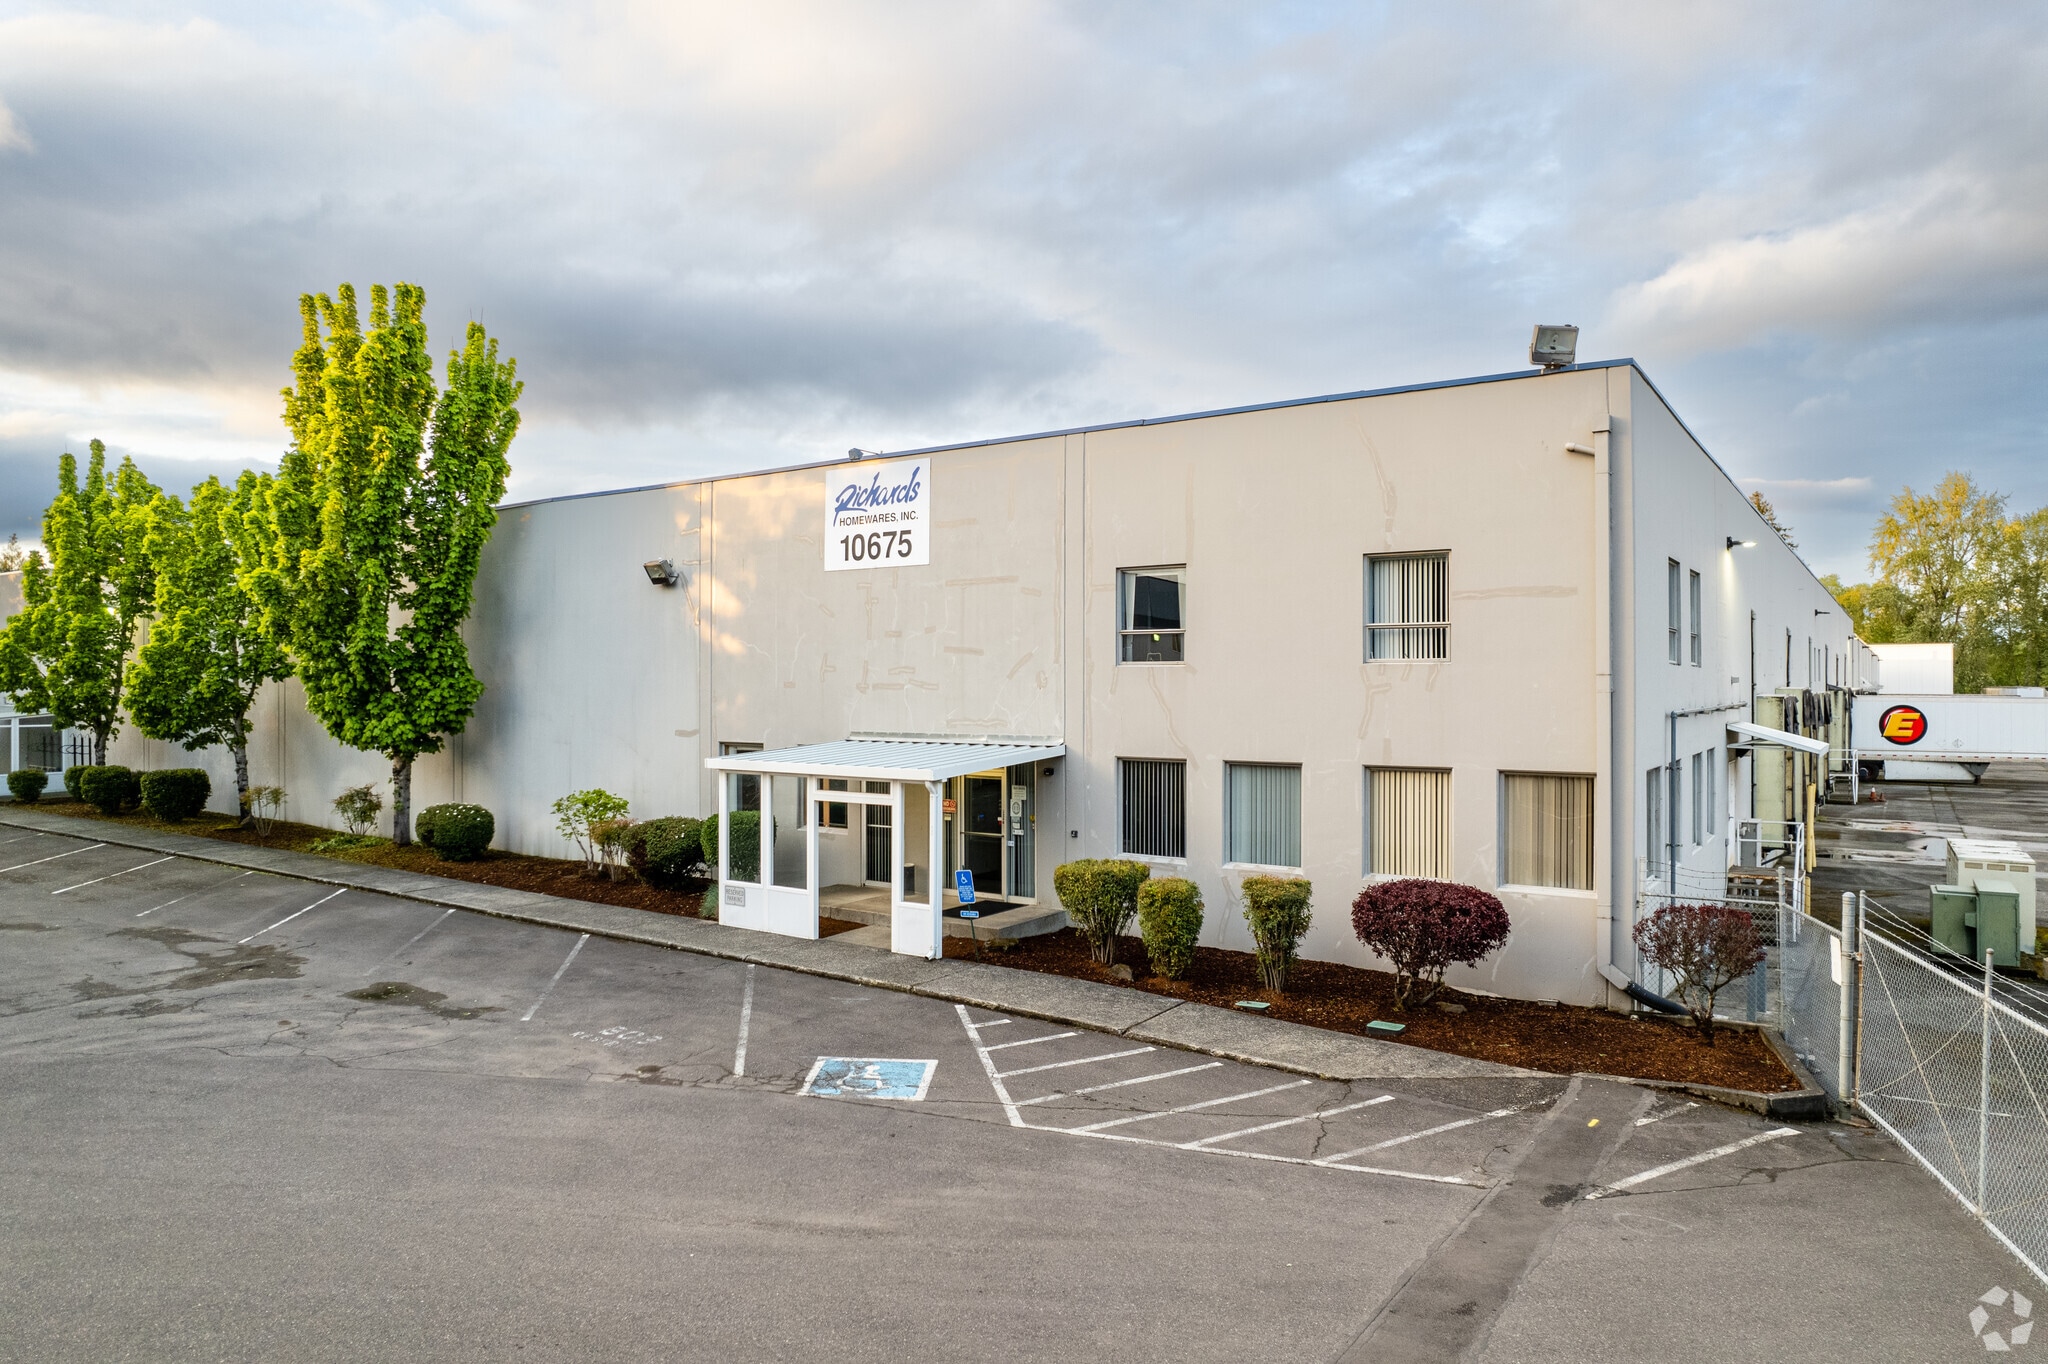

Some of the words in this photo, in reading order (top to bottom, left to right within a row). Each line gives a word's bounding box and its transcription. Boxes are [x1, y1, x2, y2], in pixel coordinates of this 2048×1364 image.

[833, 466, 921, 527] Richards
[839, 512, 899, 527] HOMEWARES,
[900, 510, 919, 521] INC.
[840, 529, 912, 561] 10675
[1883, 712, 1921, 737] E
